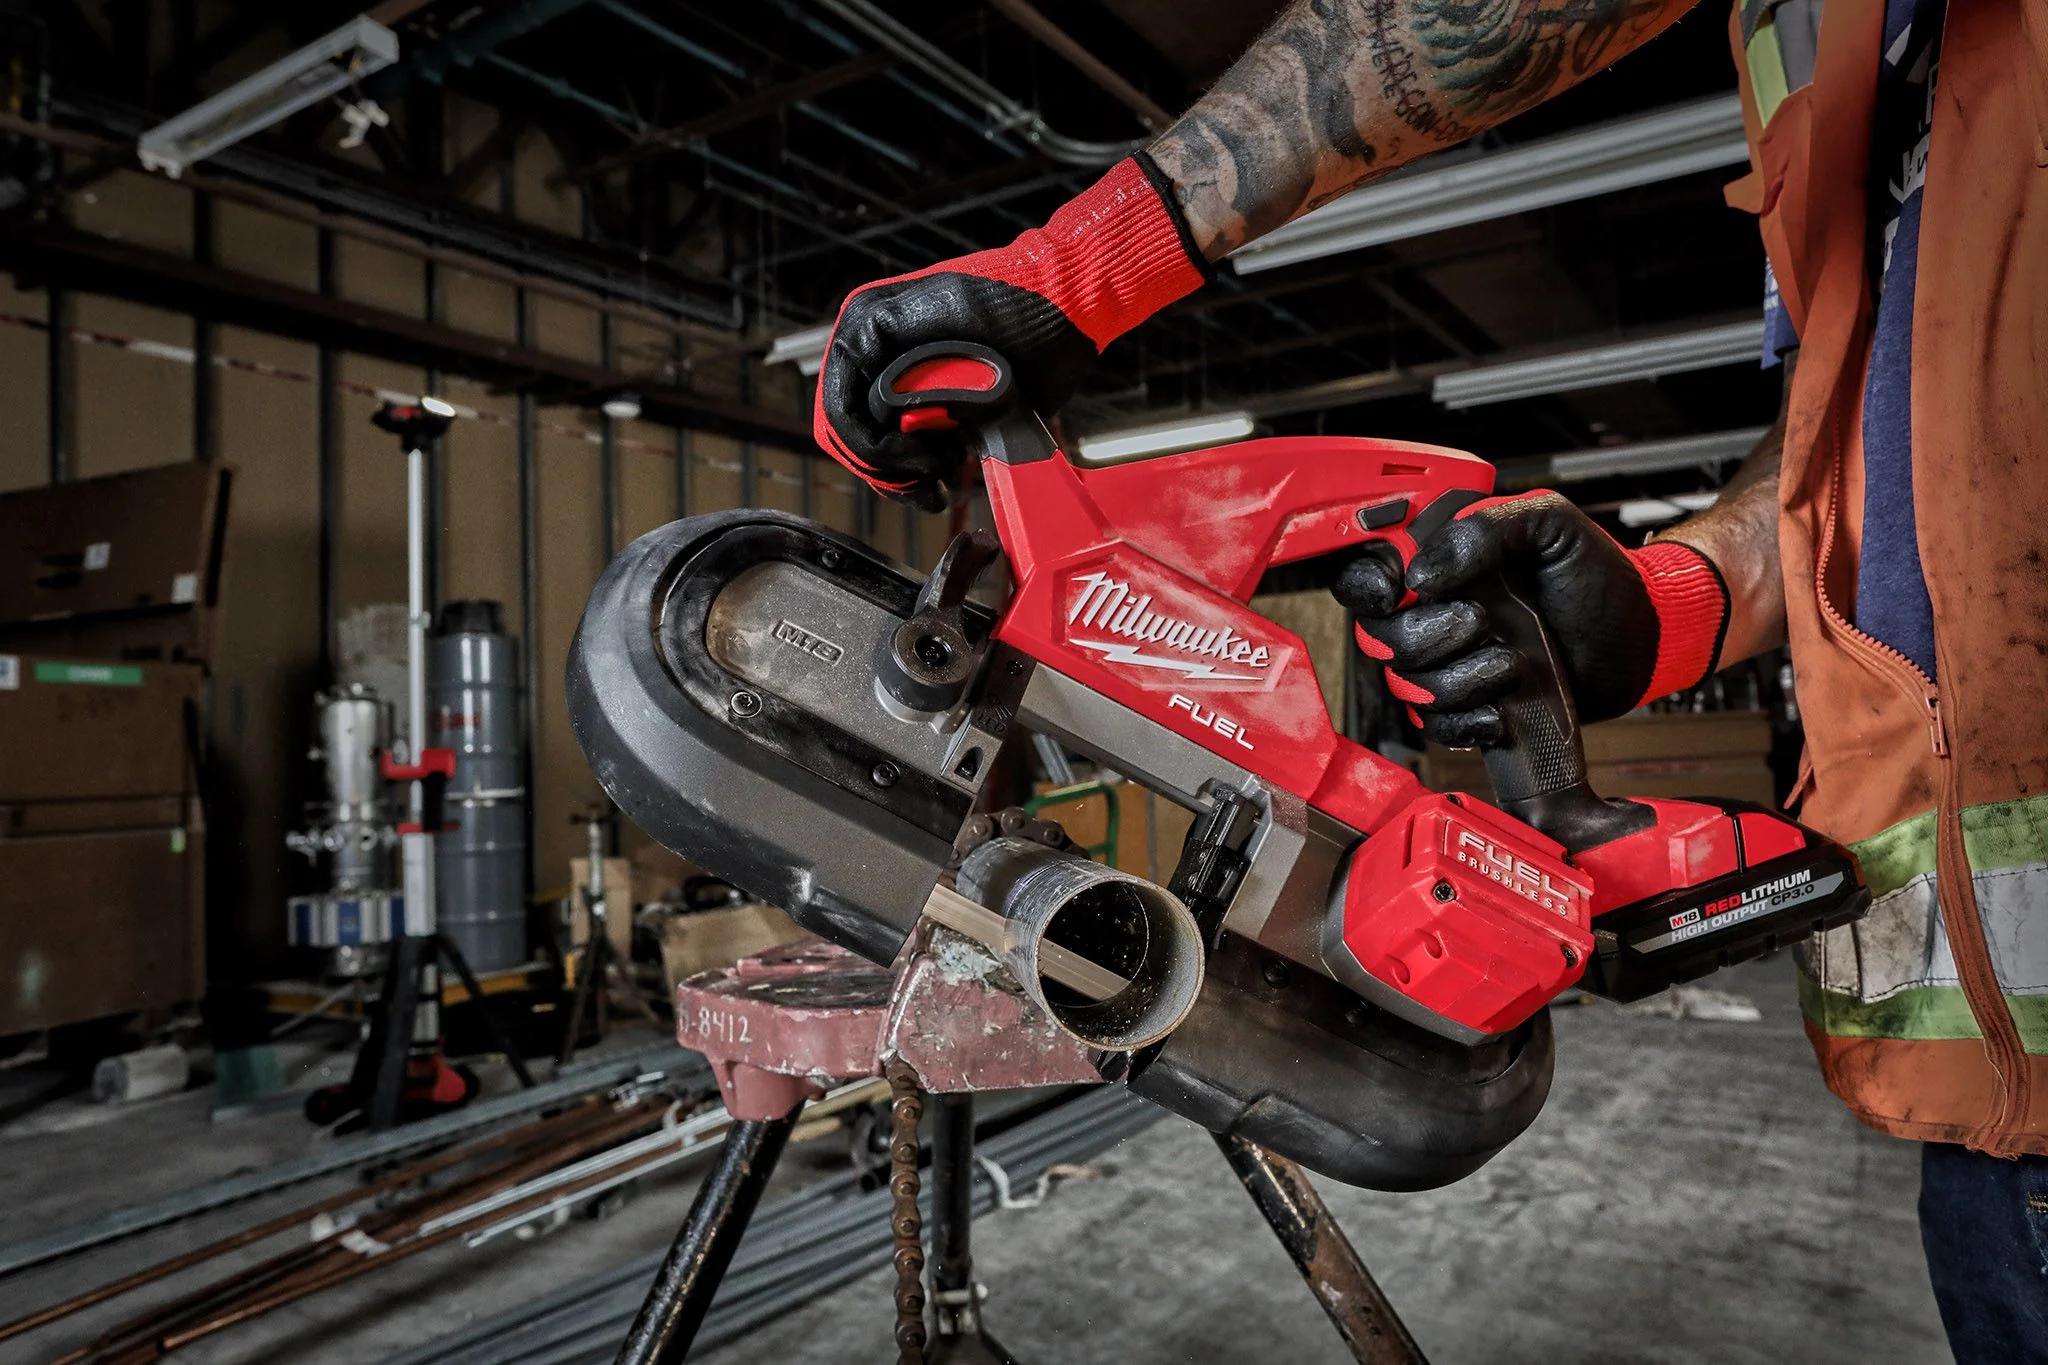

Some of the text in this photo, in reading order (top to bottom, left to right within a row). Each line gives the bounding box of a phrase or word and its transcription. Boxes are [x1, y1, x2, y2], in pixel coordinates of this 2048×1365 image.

[775, 622, 841, 663] M18
[1069, 571, 1270, 667] Milwaukee
[1168, 694, 1255, 751] FUEL
[1458, 851, 1568, 916] BRUSHLESS
[1459, 831, 1571, 902] FUEL
[1671, 868, 1811, 928] M18 REDLITHIUM
[1671, 883, 1815, 943] HIGH OUTPUT CP3.0
